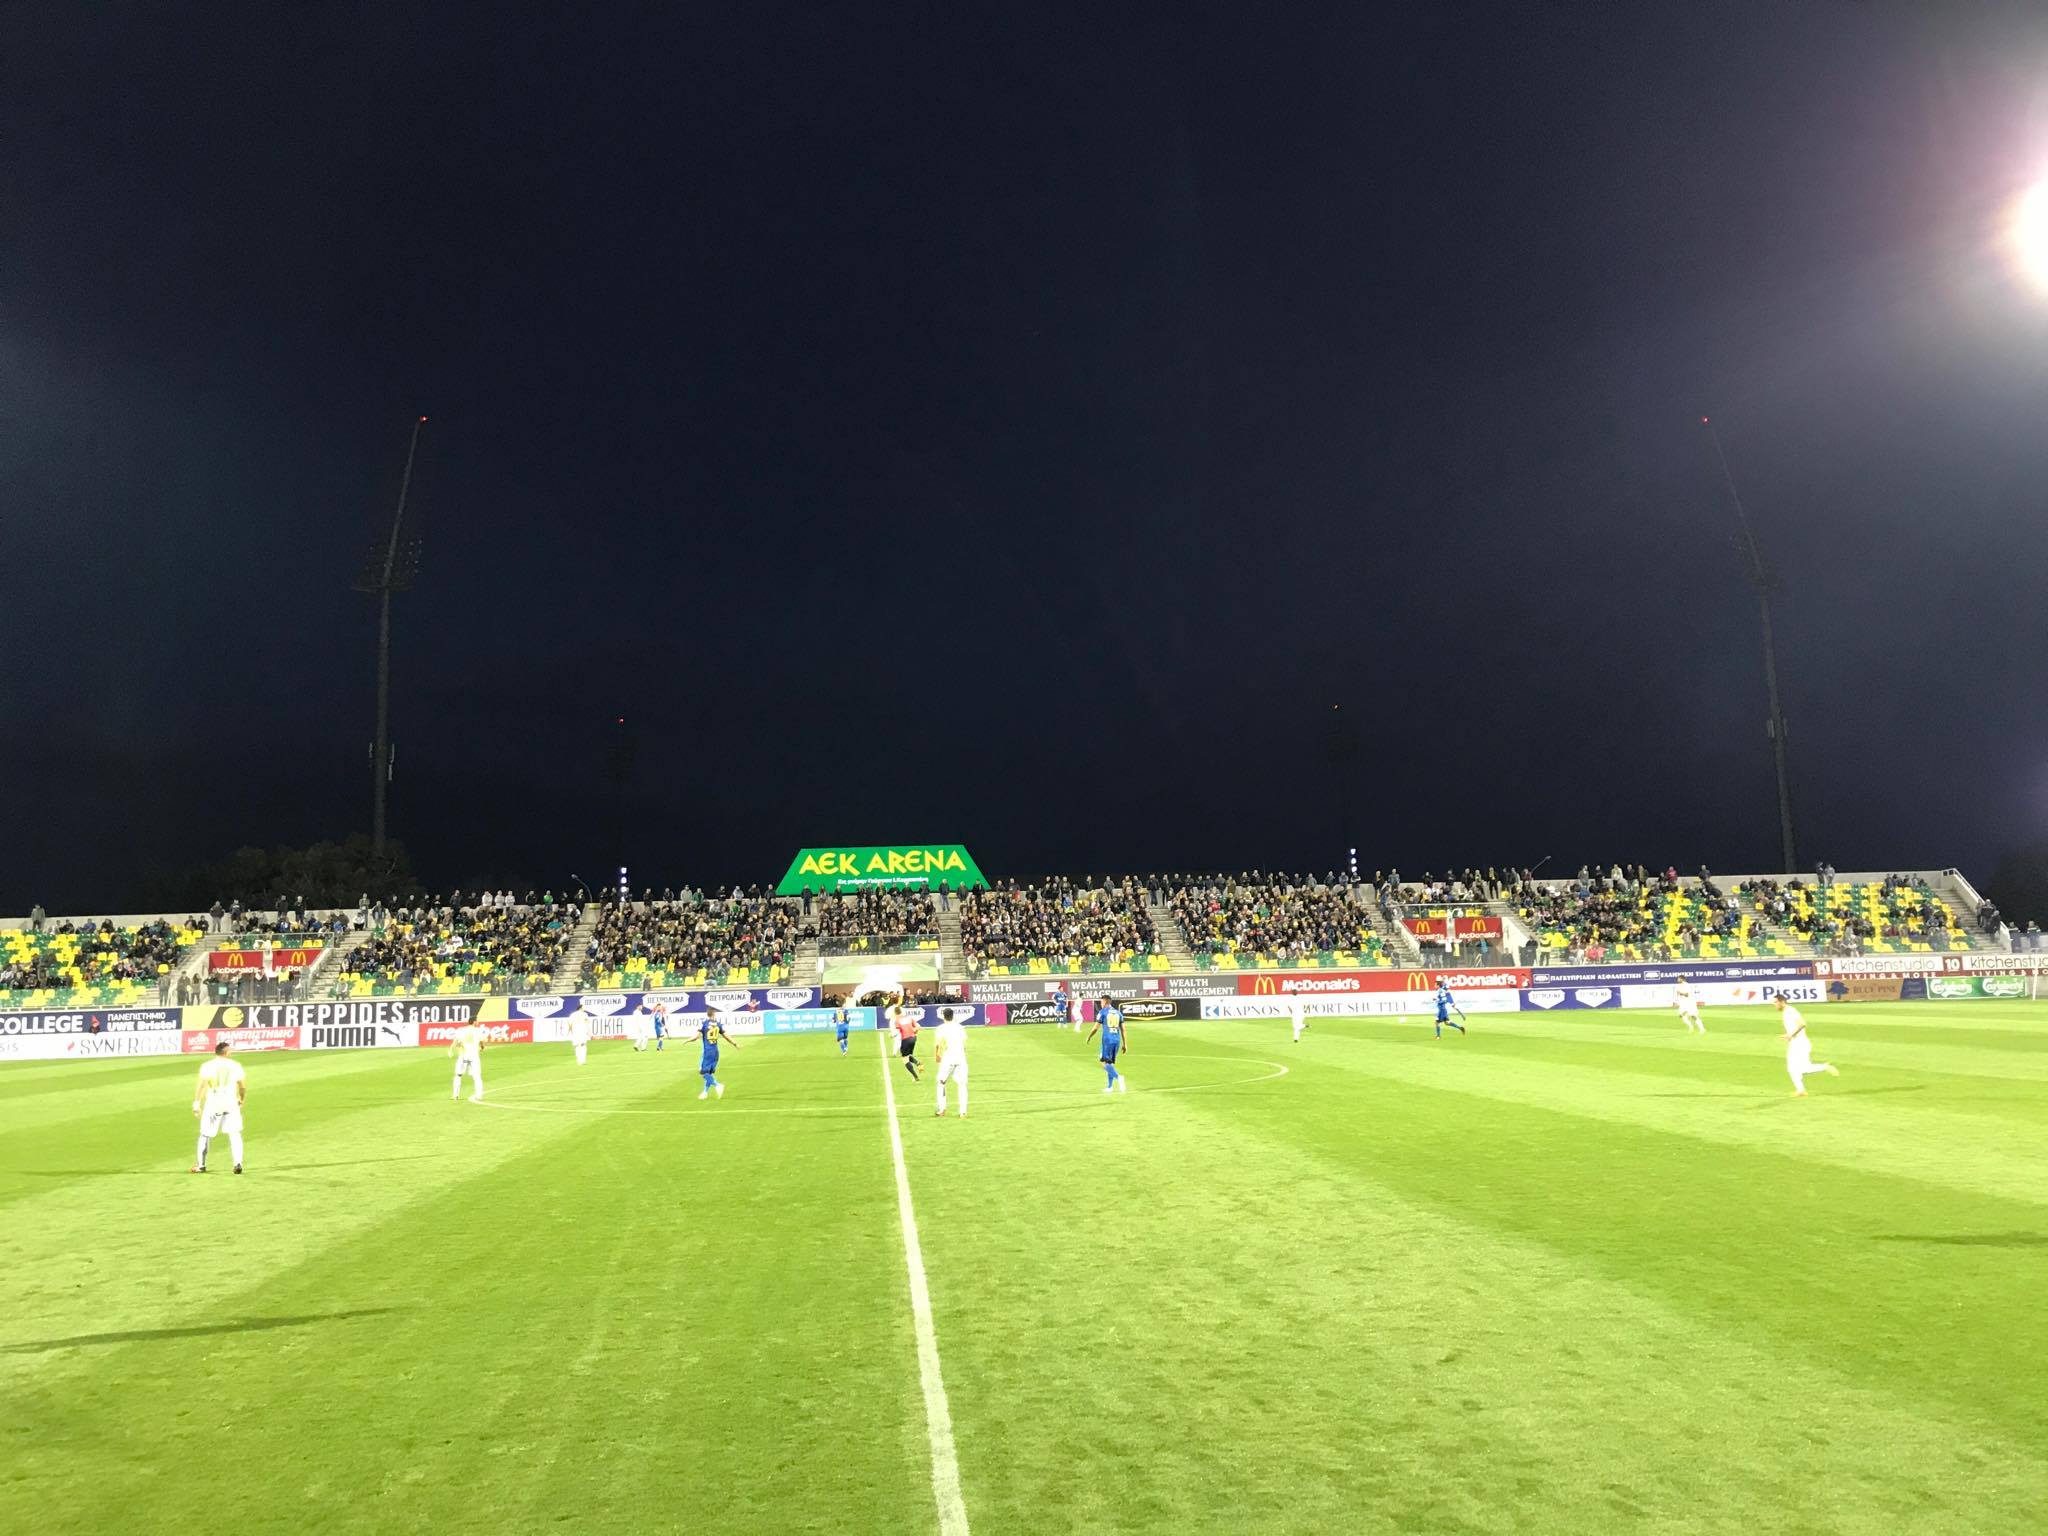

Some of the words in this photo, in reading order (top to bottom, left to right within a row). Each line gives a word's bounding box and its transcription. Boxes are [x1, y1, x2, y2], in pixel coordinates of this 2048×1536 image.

[799, 853, 860, 876] AEK
[866, 850, 966, 874] ARENA
[1815, 961, 1831, 976] 10
[1840, 959, 1936, 972] kitchenstudio
[1945, 959, 1961, 971] 10
[1742, 968, 1777, 976] HELLENIC
[1842, 972, 1885, 980] LIVING
[1903, 971, 1937, 979] MORE
[973, 983, 1012, 992] WEALTH
[1072, 981, 1111, 990] WEALTH
[1170, 979, 1208, 987] WEALTH
[1282, 978, 1360, 991] McDonald's
[973, 992, 1039, 1002] MANAGEMENT
[1170, 987, 1235, 997] MANAGEMENT
[1763, 985, 1818, 1000] Pissis
[409, 1006, 419, 1022] &
[421, 1006, 438, 1023] CO
[445, 1005, 470, 1022] LTD
[1011, 1003, 1060, 1024] plusON
[1122, 1003, 1173, 1014] ZEMCO
[1223, 1005, 1281, 1017] KAPNOS
[107, 1011, 166, 1021] ΠΑΝΕΠΙΣΤΗΜΙΟ
[107, 1020, 135, 1032] UWE
[137, 1019, 177, 1031] Bristol
[312, 1026, 375, 1048] PUMA
[511, 1029, 529, 1042] plus
